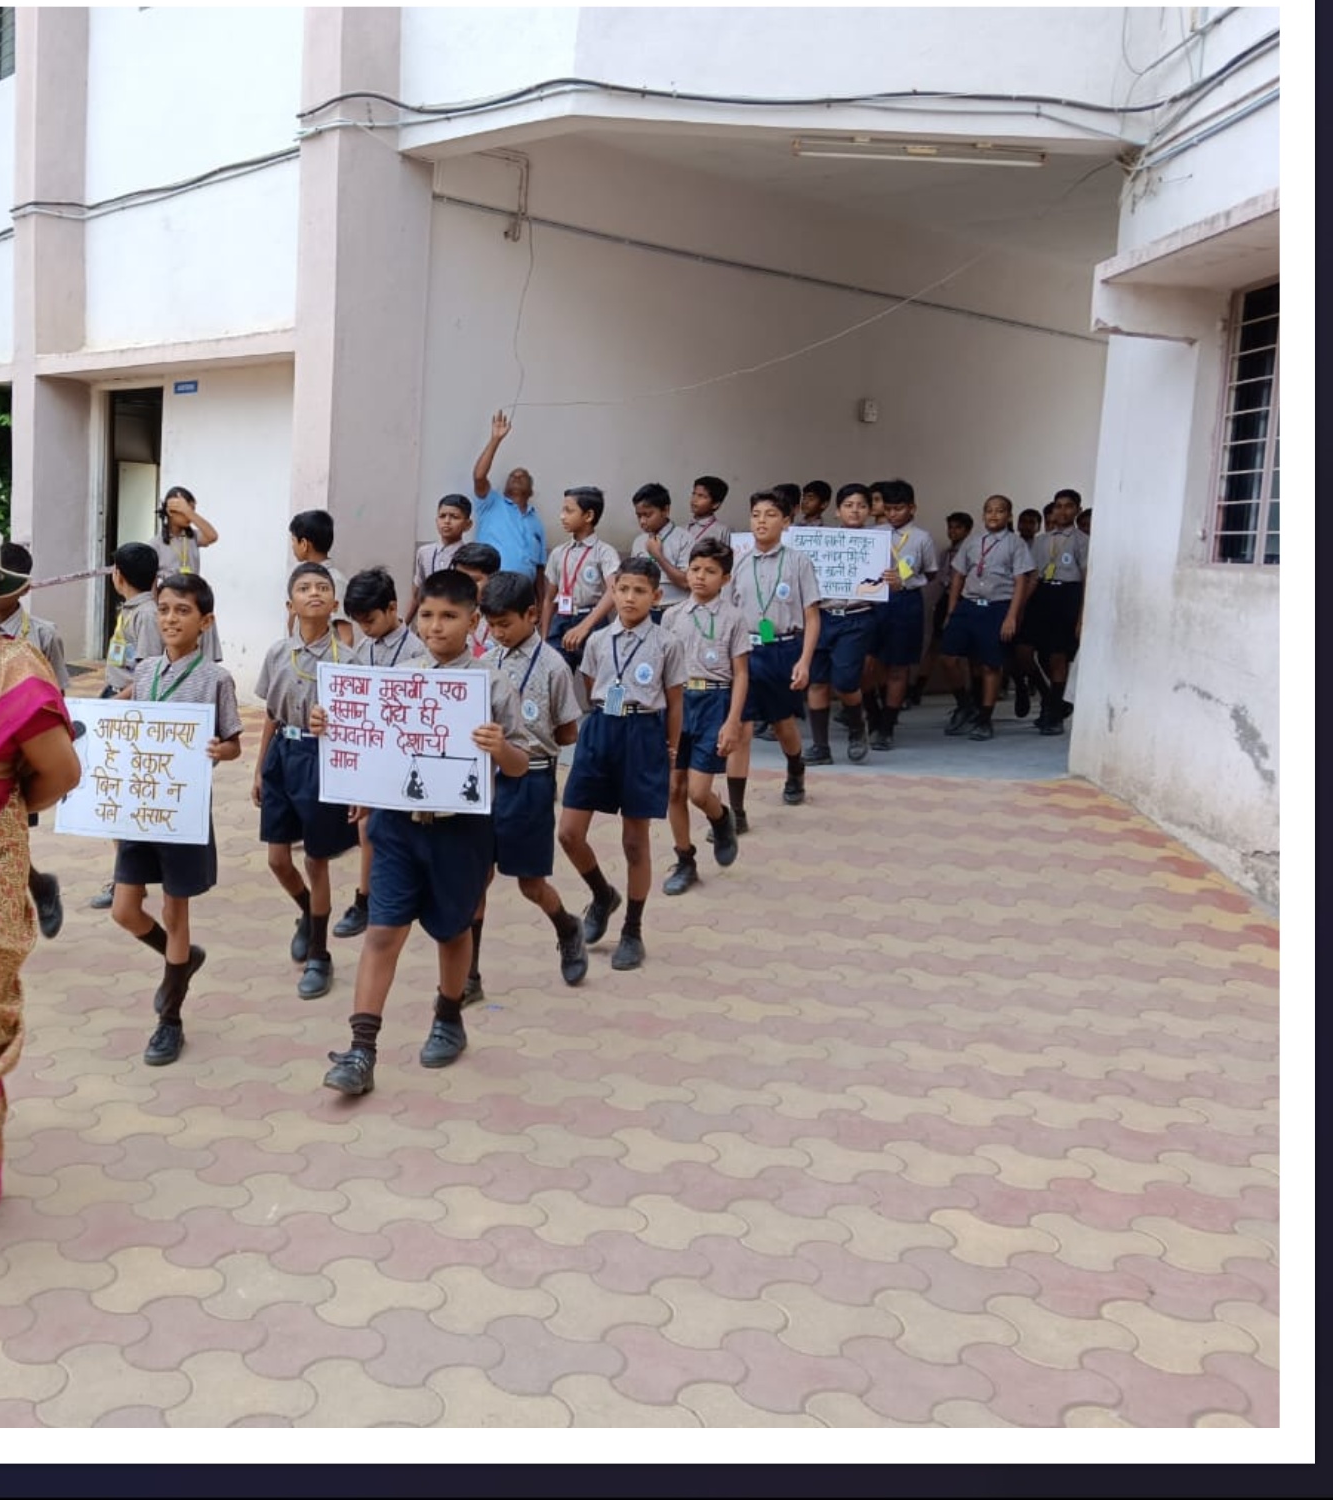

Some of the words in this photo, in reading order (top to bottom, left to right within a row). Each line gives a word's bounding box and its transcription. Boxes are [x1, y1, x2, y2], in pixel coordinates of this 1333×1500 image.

[329, 674, 372, 698] मुलगा
[436, 680, 468, 702] एक
[418, 697, 443, 728] ही
[93, 709, 144, 742] आपकी
[146, 721, 201, 749] लालसा
[392, 724, 450, 756] देशाची
[130, 742, 176, 781] बेकार
[329, 749, 360, 772] मान
[90, 766, 123, 797] बिन
[166, 782, 188, 803] न
